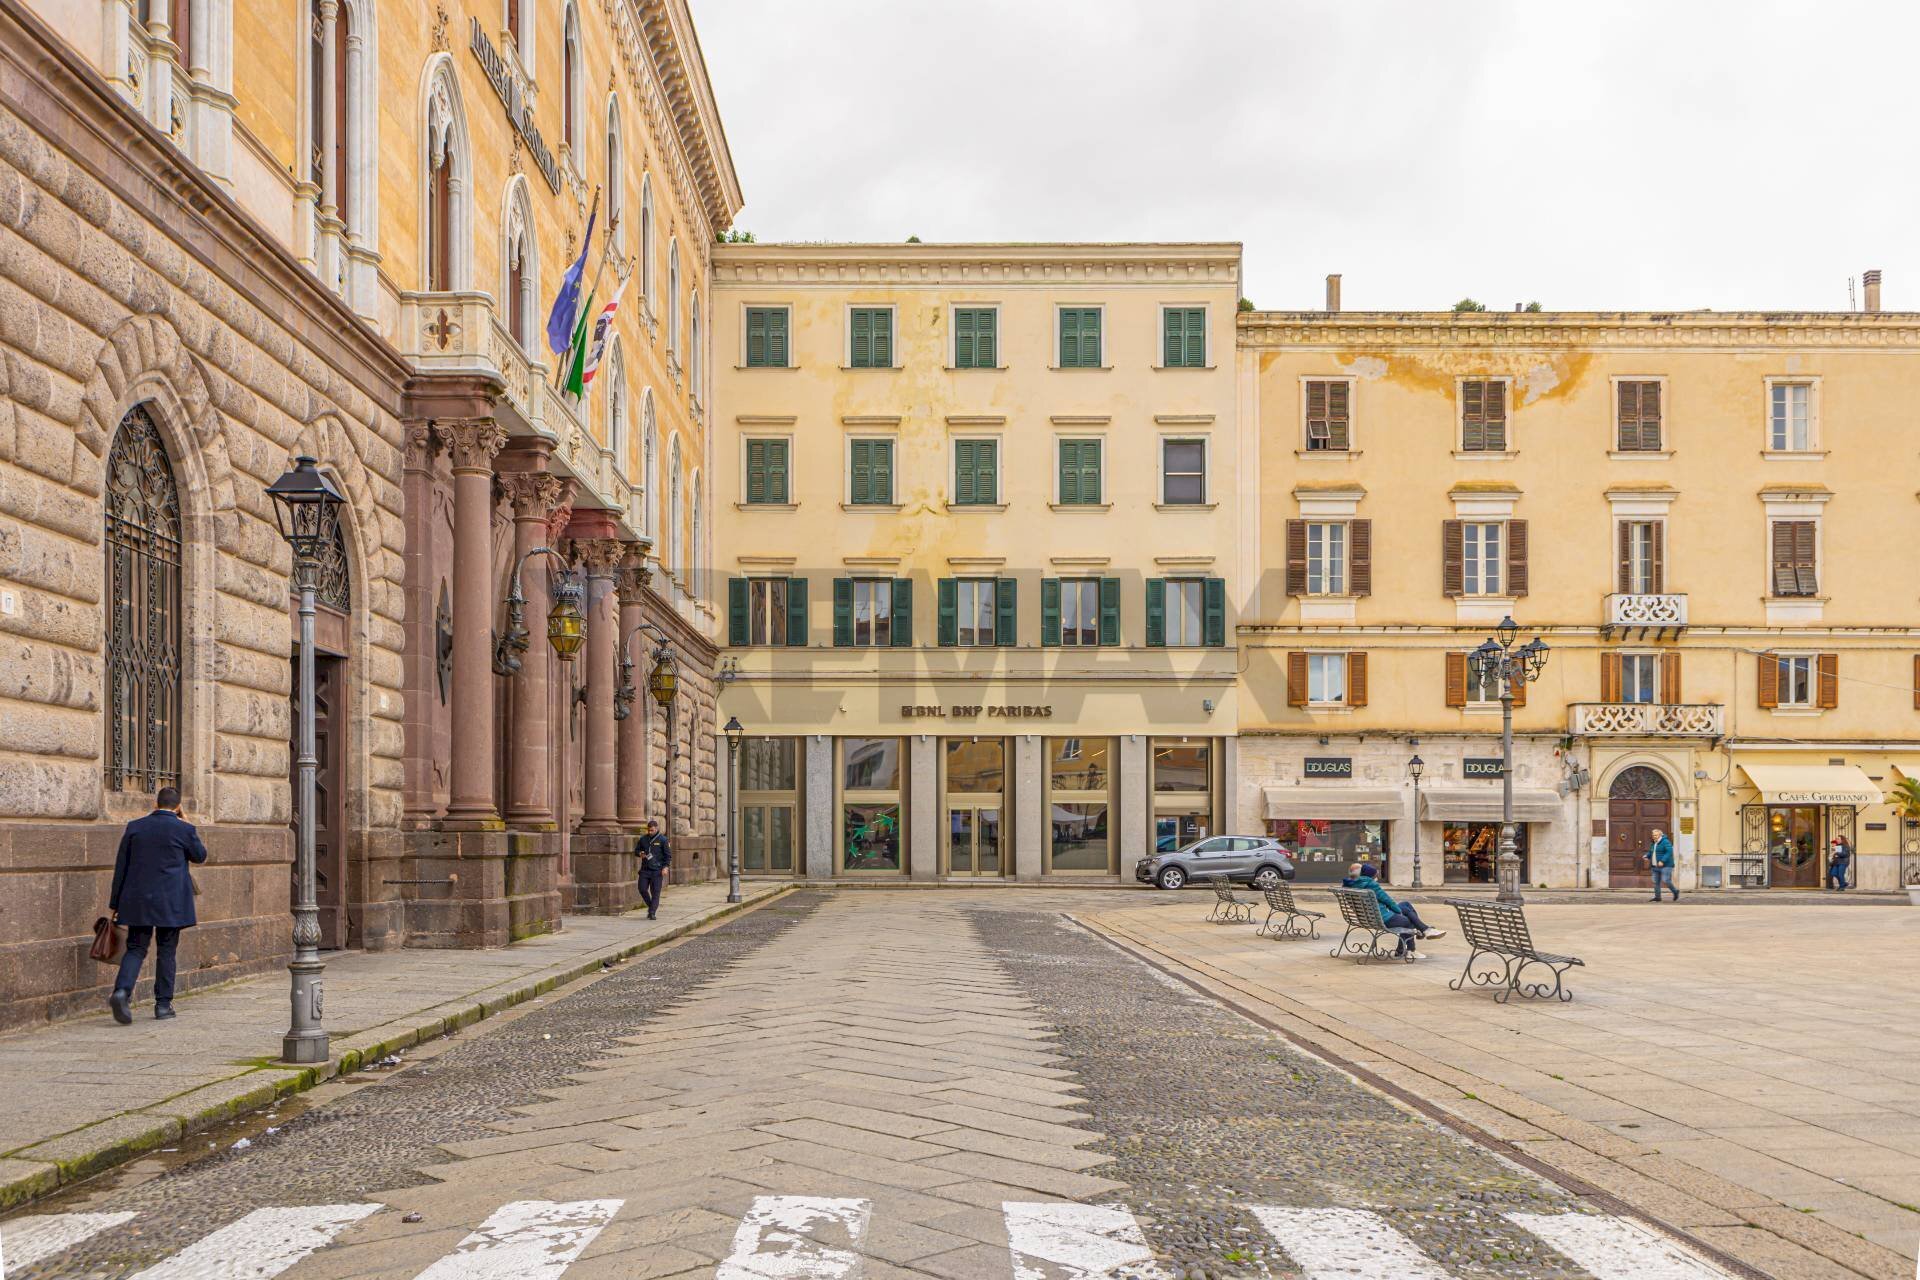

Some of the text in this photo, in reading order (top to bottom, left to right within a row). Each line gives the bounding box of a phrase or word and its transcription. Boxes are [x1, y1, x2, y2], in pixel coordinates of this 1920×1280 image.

[916, 705, 1053, 717] BNL BNP PARIBAS
[1306, 762, 1351, 772] DOUGLAS
[1466, 763, 1504, 773] DOUGLA
[1811, 791, 1868, 801] GIORDANO
[1301, 827, 1328, 837] SALE
